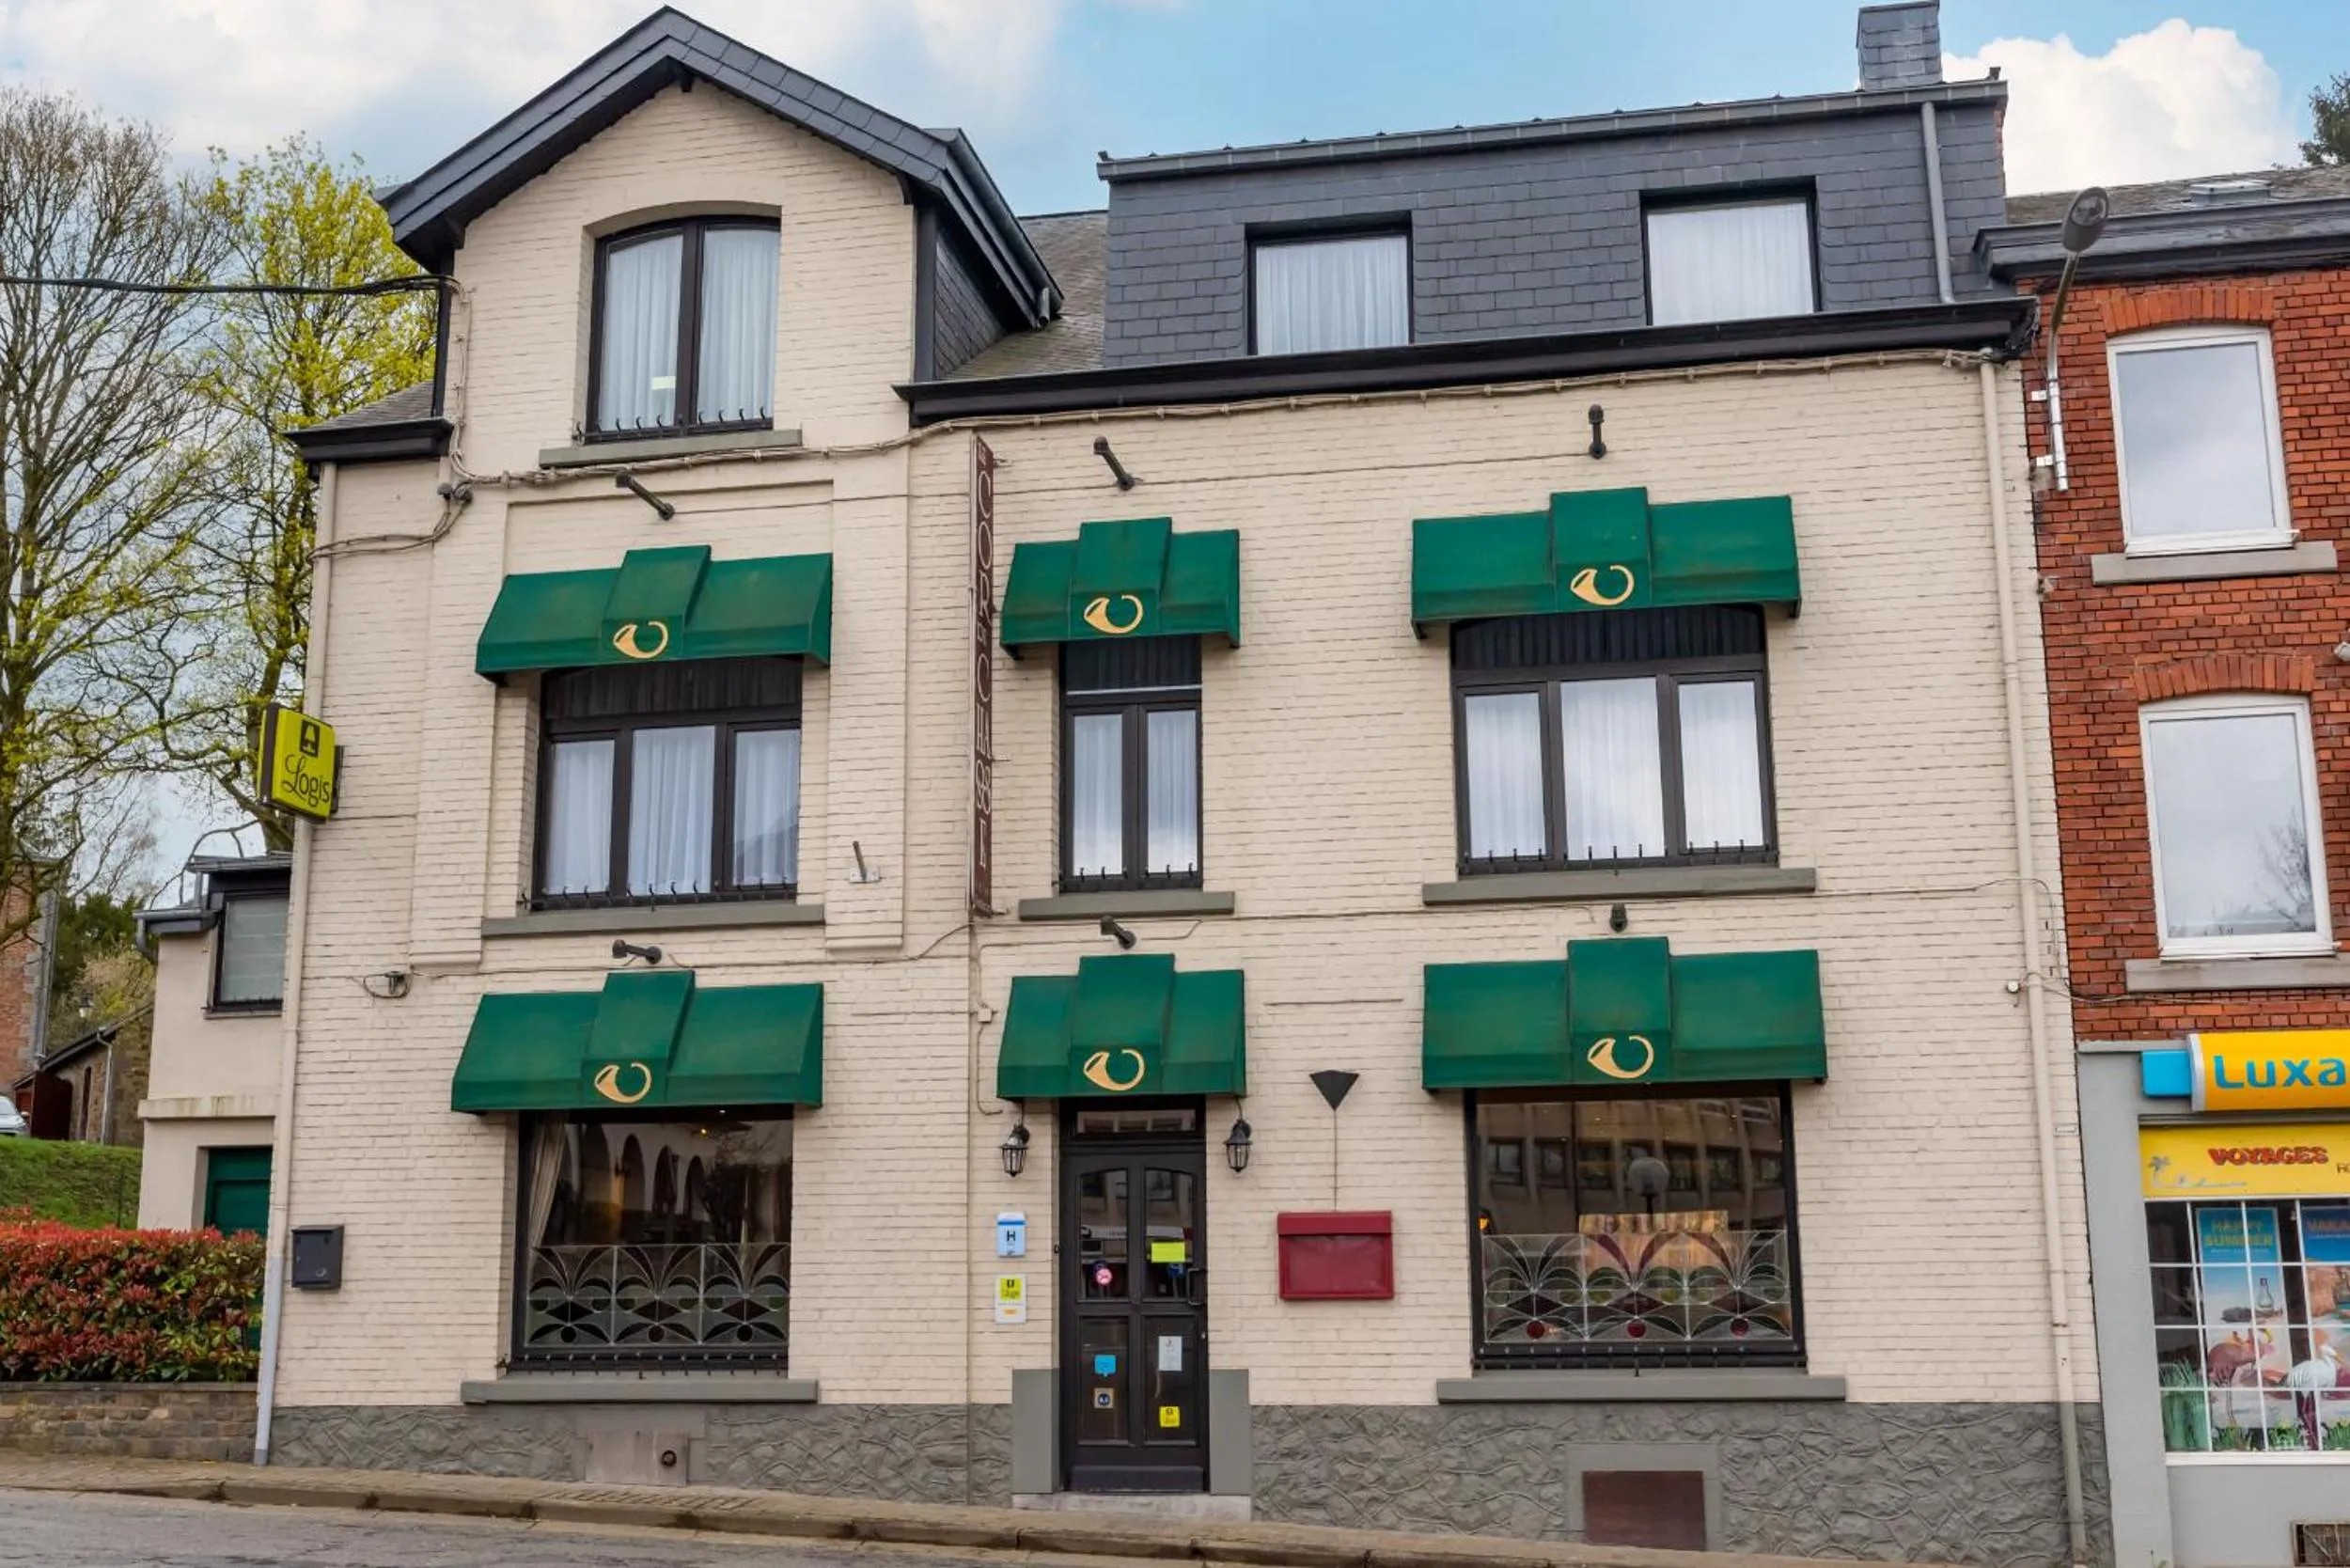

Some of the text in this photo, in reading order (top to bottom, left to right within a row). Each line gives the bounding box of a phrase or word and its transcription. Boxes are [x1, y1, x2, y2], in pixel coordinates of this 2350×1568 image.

[282, 754, 330, 808] Logis
[2214, 1054, 2347, 1089] Luxa
[2207, 1146, 2329, 1167] VOYAGES
